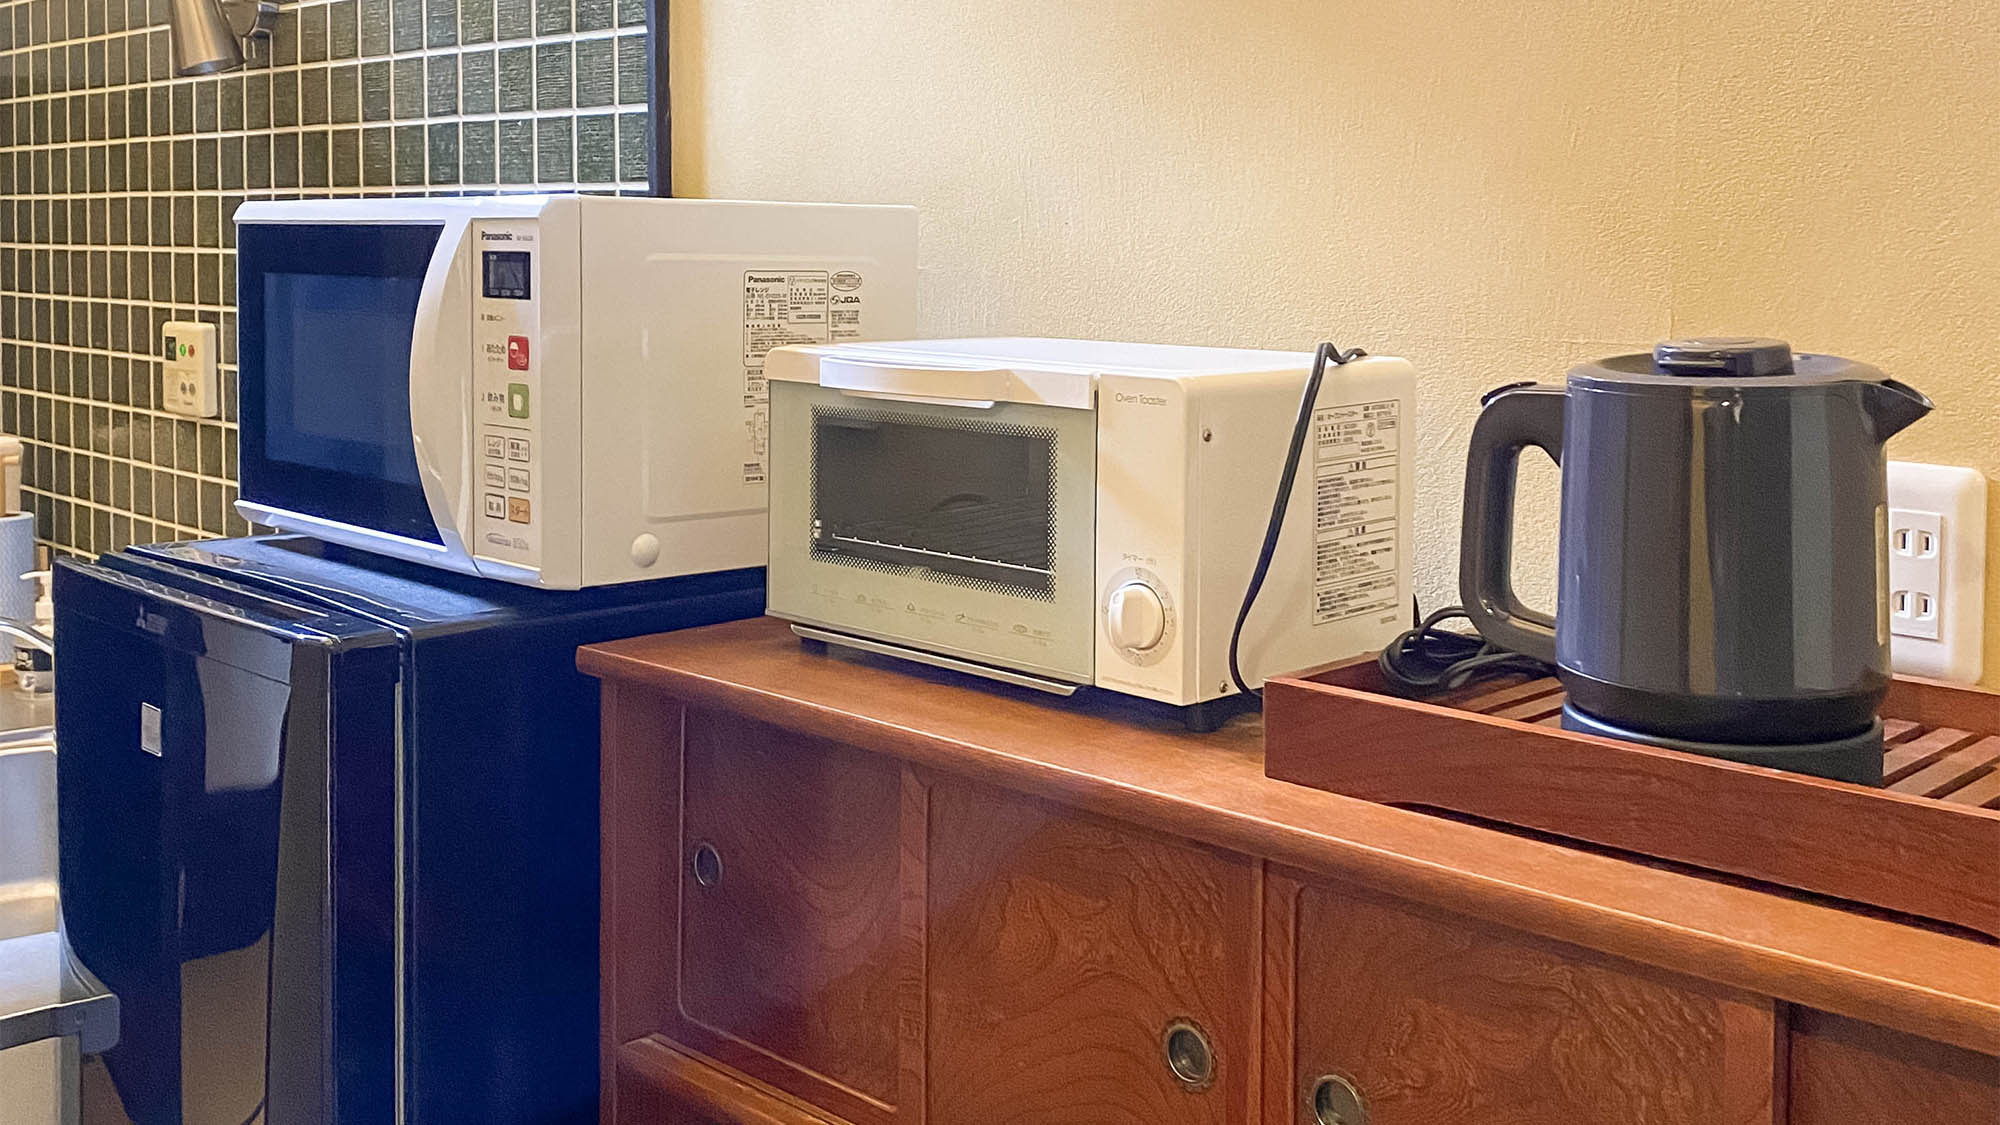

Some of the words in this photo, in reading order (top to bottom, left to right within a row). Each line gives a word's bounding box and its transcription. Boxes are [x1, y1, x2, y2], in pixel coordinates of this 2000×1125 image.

[481, 230, 513, 241] Panasonic
[748, 275, 785, 283] Panasonic
[840, 296, 860, 304] JQA
[1115, 392, 1138, 404] Oven
[1139, 394, 1168, 406] Toaster
